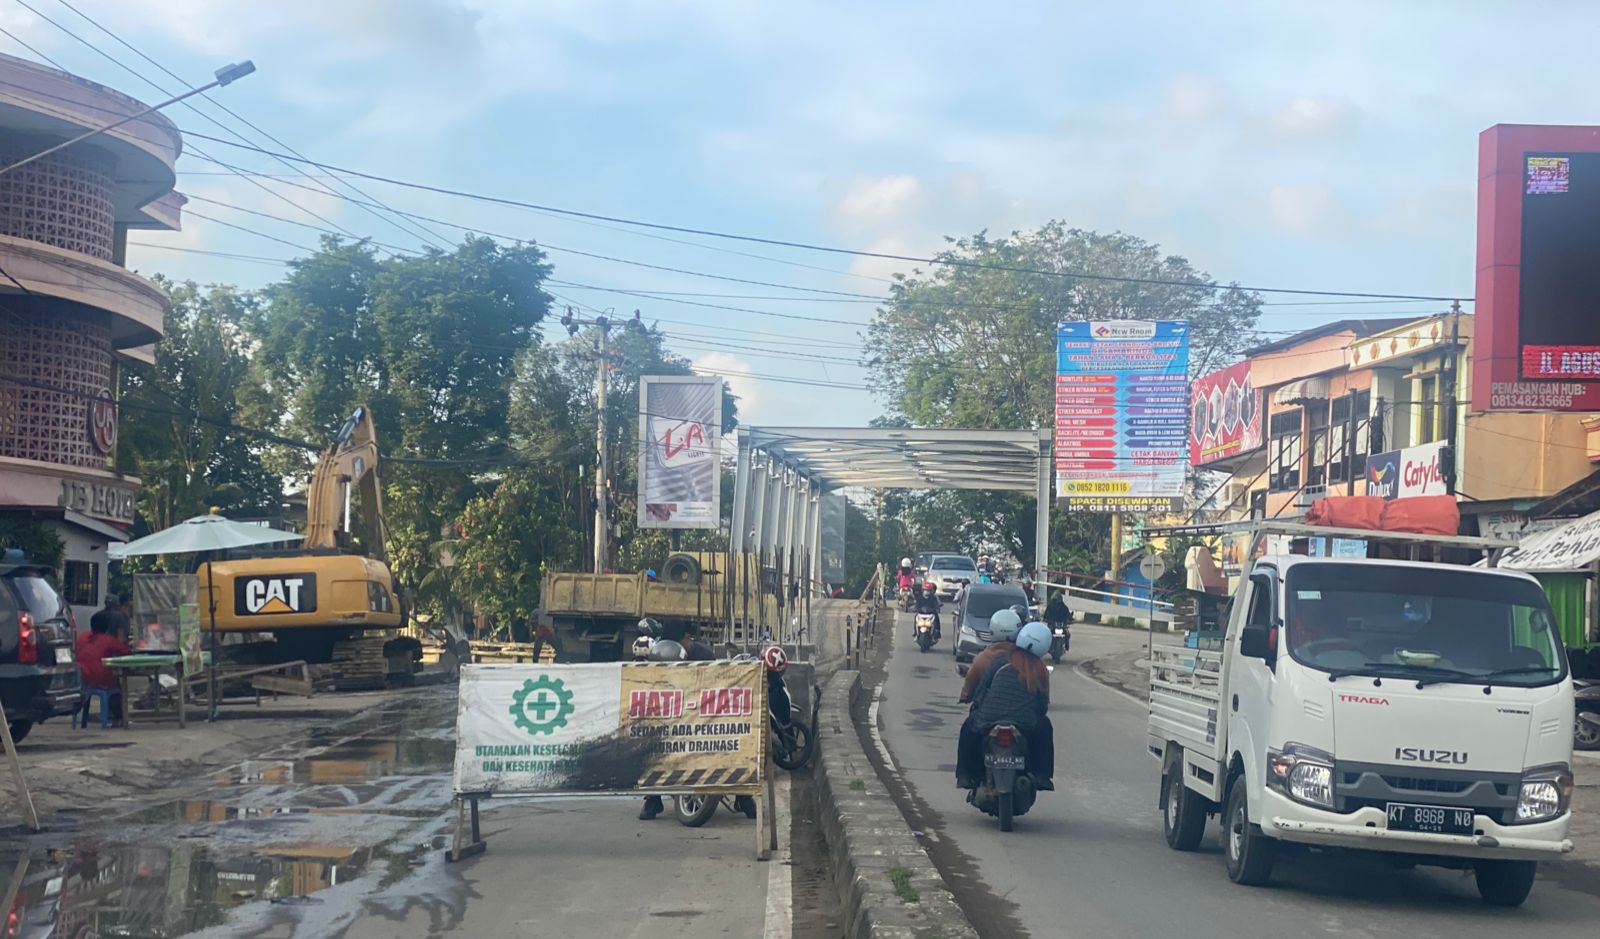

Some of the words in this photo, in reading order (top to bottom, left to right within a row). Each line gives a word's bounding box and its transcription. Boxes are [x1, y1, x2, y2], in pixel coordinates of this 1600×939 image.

[1492, 382, 1559, 394] PEMASANGAN
[1560, 383, 1586, 395] HUB:
[1492, 395, 1572, 407] 081348235665
[1095, 482, 1110, 492] 1820
[246, 579, 303, 613] CAT
[1339, 694, 1390, 706] TRAGA
[630, 724, 670, 738] SEDANG
[672, 724, 692, 736] ADA
[694, 722, 751, 735] PEKERJAAN
[476, 744, 531, 757] UTAMAKAN
[688, 738, 740, 752] DRAINASE
[1395, 748, 1468, 764] ISUZU
[482, 760, 502, 772] DAN
[1390, 805, 1406, 822] KT
[1414, 808, 1444, 824] 8968
